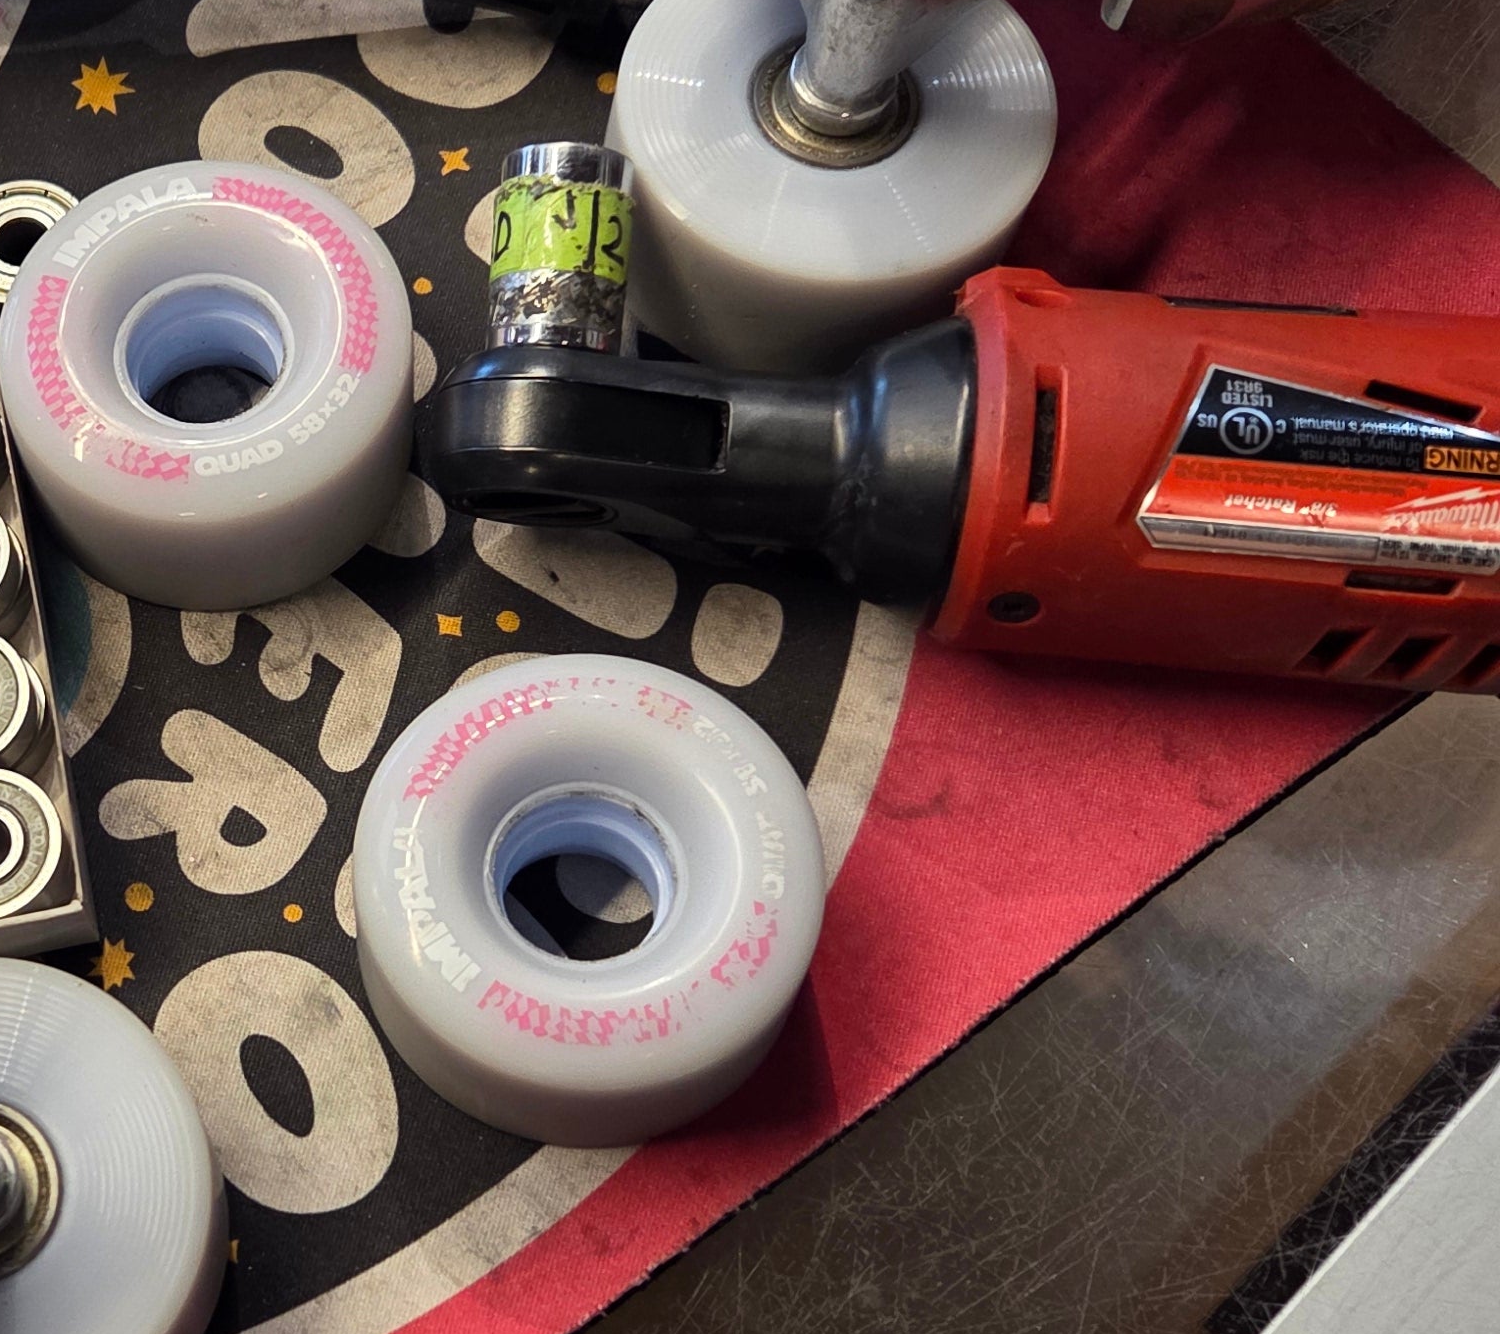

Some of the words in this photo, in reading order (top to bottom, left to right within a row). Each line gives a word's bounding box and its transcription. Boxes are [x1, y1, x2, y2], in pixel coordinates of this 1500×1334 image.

[52, 176, 200, 270] IMPALA
[1221, 391, 1274, 408] LISTED
[194, 438, 285, 477] QUAD
[287, 371, 364, 447] 58x32
[1196, 413, 1218, 429] US
[1293, 431, 1327, 446] must
[1329, 435, 1361, 447] user
[1301, 447, 1326, 461] risk
[1355, 451, 1403, 466] reduce
[1223, 493, 1297, 515] Ratchet
